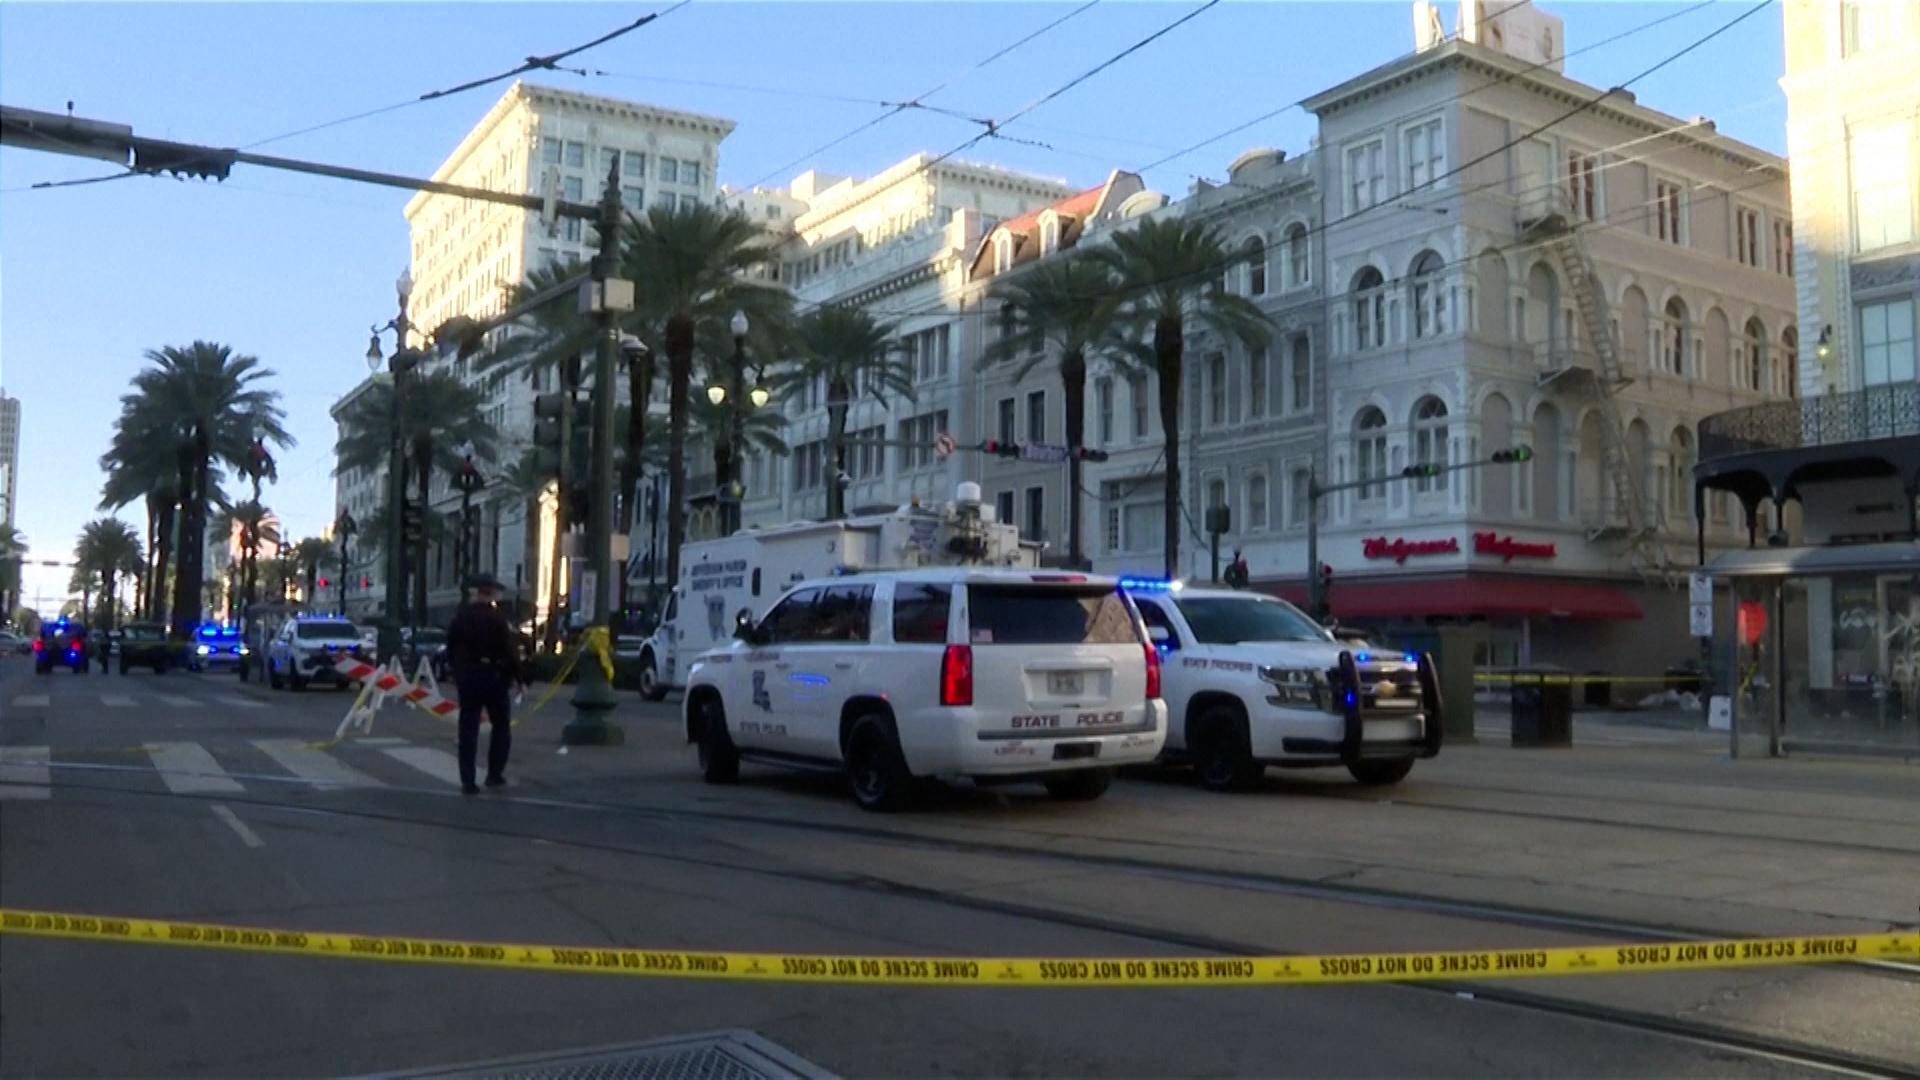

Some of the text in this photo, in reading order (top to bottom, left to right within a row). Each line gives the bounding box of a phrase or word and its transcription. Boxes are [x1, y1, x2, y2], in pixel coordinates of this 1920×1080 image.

[1362, 535, 1460, 565] Walgreens
[1011, 711, 1124, 728] STATE POLICE
[1617, 938, 1857, 964] CRIME SCENE DO NOT CROSS
[782, 958, 979, 978] CRIME SCENE DO NOT CROSS
[1040, 960, 1254, 979] CRIME SCENE DO NOT CROSS
[1320, 951, 1547, 975] CRIME SCENE DO NOT CROSS
